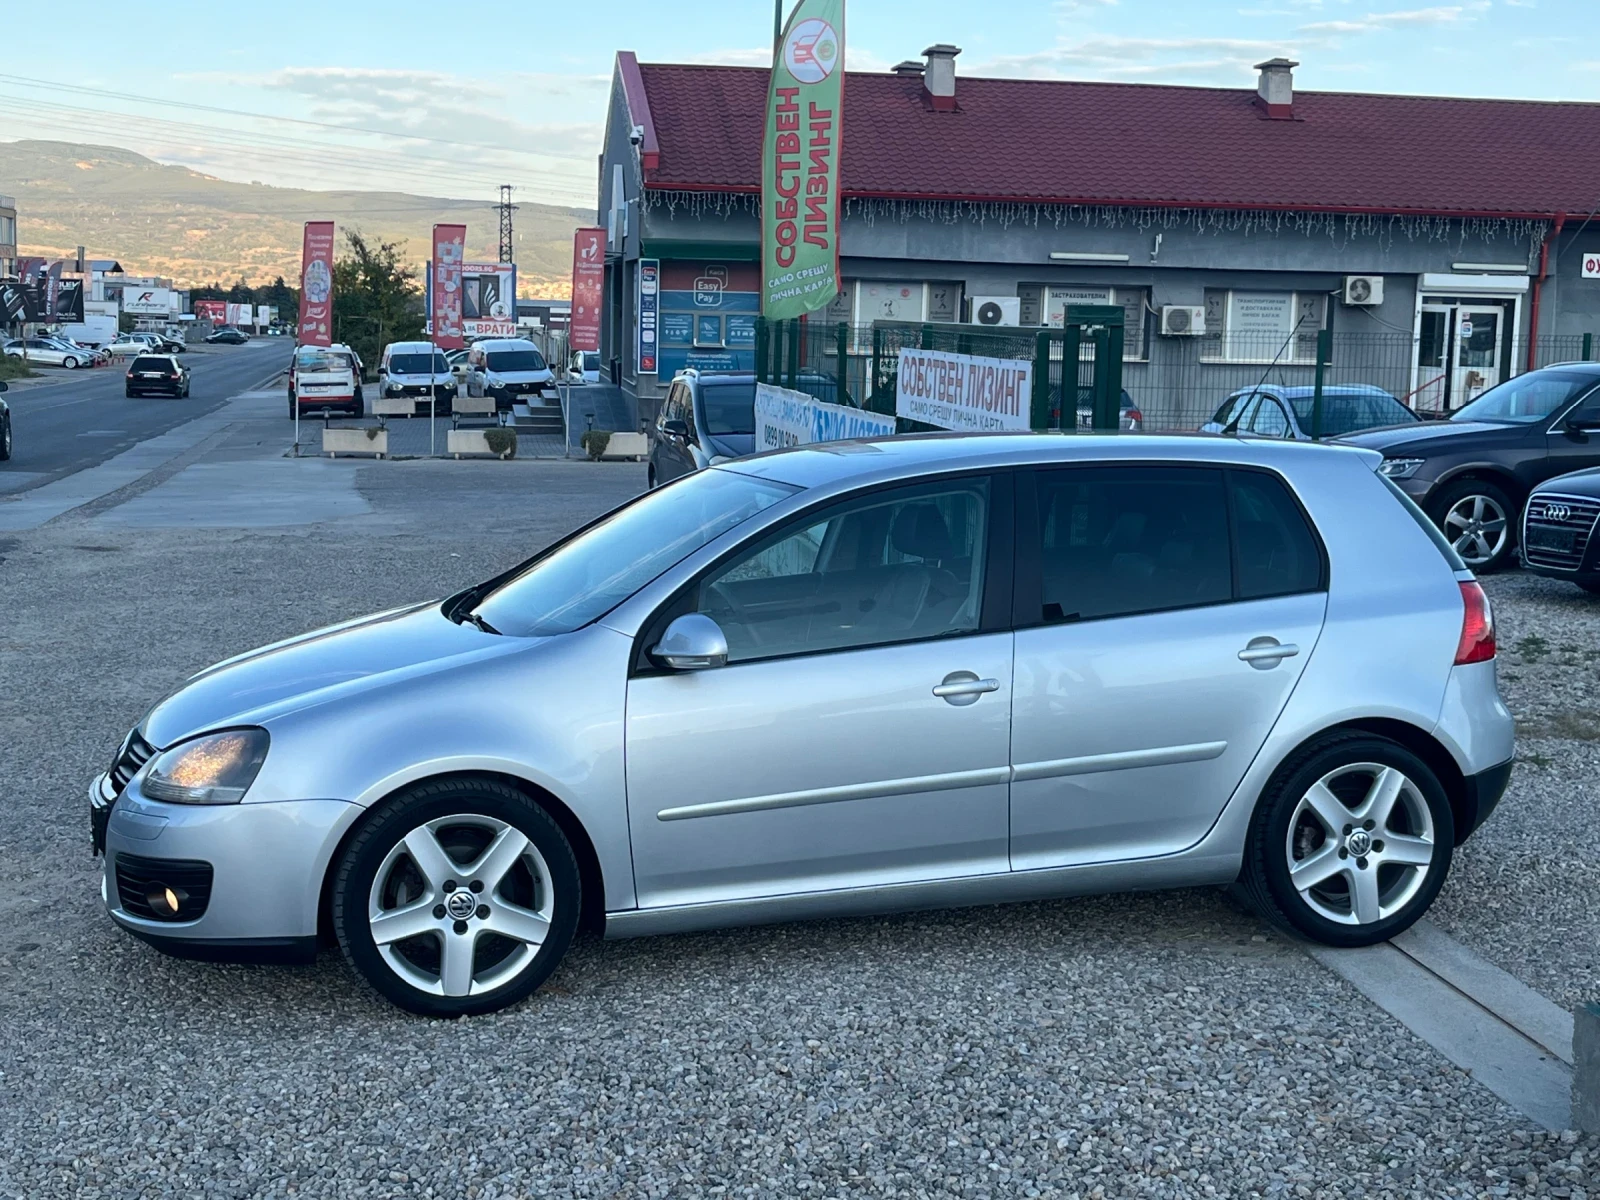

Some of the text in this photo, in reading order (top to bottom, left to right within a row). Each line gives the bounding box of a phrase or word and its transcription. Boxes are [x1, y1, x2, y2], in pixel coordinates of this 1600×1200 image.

[776, 87, 801, 268] СОБСТВЕН
[804, 102, 832, 250] ЛИЗИНГ
[698, 282, 718, 292] Easy
[768, 263, 829, 288] САМО СРЕЩУ
[698, 294, 713, 303] Pay
[769, 276, 833, 304] ЛИЧНА КАРТА
[476, 324, 514, 335] ВРАТИ
[901, 355, 1026, 416] СОБСТВЕН ЛИЗИНГ
[910, 400, 1004, 431] САМО СРЕЩУ ЛИЧНА КАРТА
